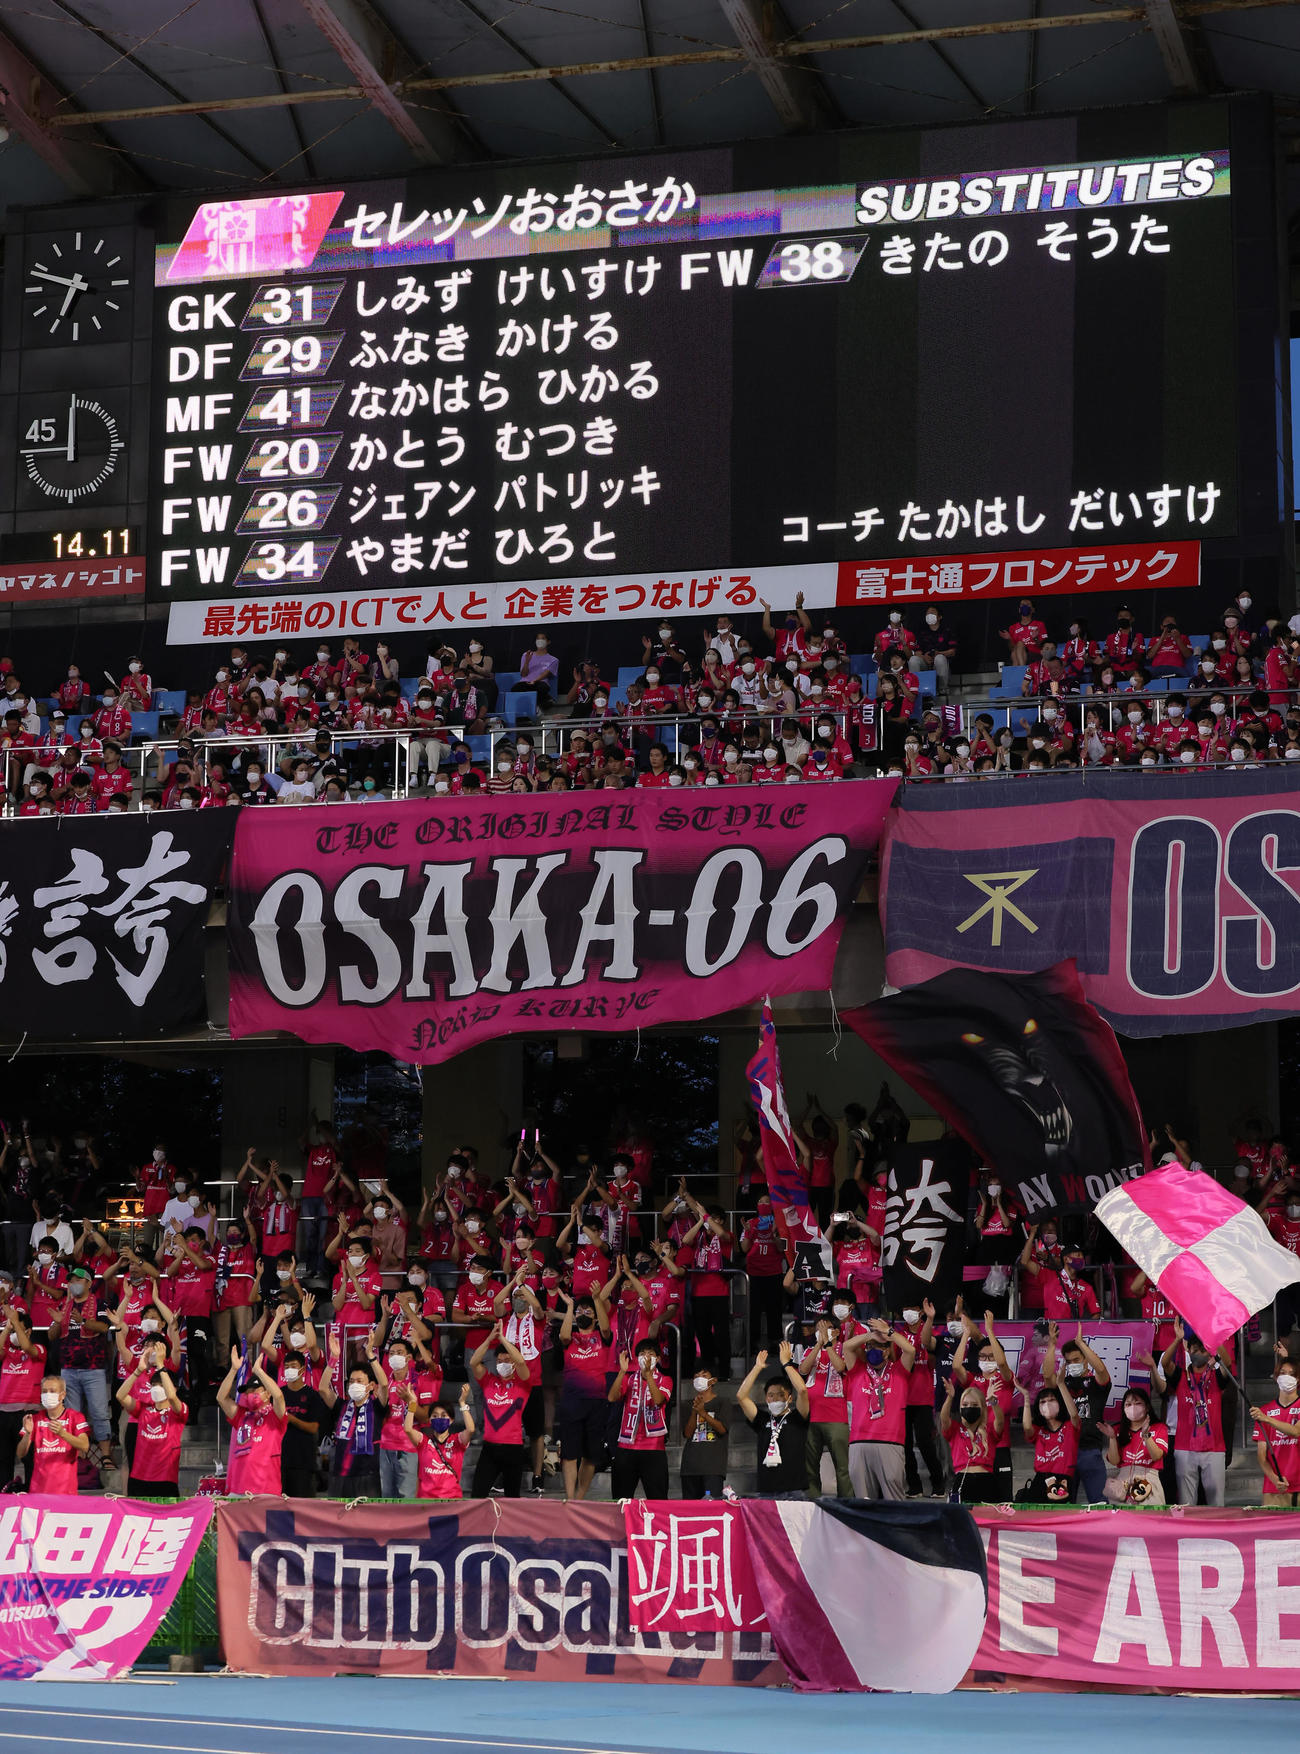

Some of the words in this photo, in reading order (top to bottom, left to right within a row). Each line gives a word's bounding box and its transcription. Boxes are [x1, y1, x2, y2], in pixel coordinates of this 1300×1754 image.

[344, 176, 696, 249] セレッソおおさか
[857, 156, 1215, 229] SUBSTITUTES
[680, 248, 754, 291] FW
[780, 241, 845, 282] 38
[880, 228, 1009, 276] きたの
[1036, 213, 1171, 261] そうた
[167, 292, 236, 332] GK
[262, 285, 314, 325] 31
[356, 268, 473, 317] しみず
[498, 256, 662, 307] けいすけ
[169, 342, 234, 383] DF
[261, 336, 322, 375] 29
[349, 323, 470, 369] ふなき
[496, 311, 620, 357] かける
[25, 418, 56, 443] 45
[166, 393, 234, 433] MF
[259, 387, 312, 426] 41
[348, 371, 509, 420] なかはら
[538, 360, 659, 405] ひかる
[164, 444, 233, 484] FW
[259, 438, 320, 477] 20
[347, 426, 466, 471] かとう
[496, 415, 618, 462] むつき
[162, 495, 232, 535] FW
[258, 489, 318, 529] 26
[347, 481, 476, 524] ジェアン
[494, 465, 661, 513] パトリッキ
[783, 507, 885, 542] コーチ
[897, 500, 1046, 542] たかはし
[1068, 481, 1221, 532] だいすけ
[53, 529, 129, 558] 14.11
[161, 546, 231, 587] FW
[256, 541, 318, 581] 34
[345, 528, 470, 576] やまだ
[495, 521, 616, 565] ひろと
[855, 550, 1179, 600] 富士通フロンテック
[203, 591, 488, 638] 最先端のICTで人と
[504, 572, 758, 622] 企業をつなげる
[316, 821, 399, 855] THE
[415, 804, 640, 845] ORIGINAL
[656, 801, 808, 836] STYLE
[247, 833, 848, 1007] OSAKA-06
[1126, 809, 1300, 1000] OS
[877, 1159, 966, 1284] 誇
[1152, 1302, 1166, 1316] 10
[36, 1446, 66, 1454] YANMAR
[424, 1466, 453, 1475] YANMA
[91, 1575, 171, 1600] SIDE!!
[247, 1540, 445, 1651] Club
[630, 1512, 768, 1627] 颯
[978, 1527, 1060, 1657] E
[1092, 1536, 1300, 1669] ARE
